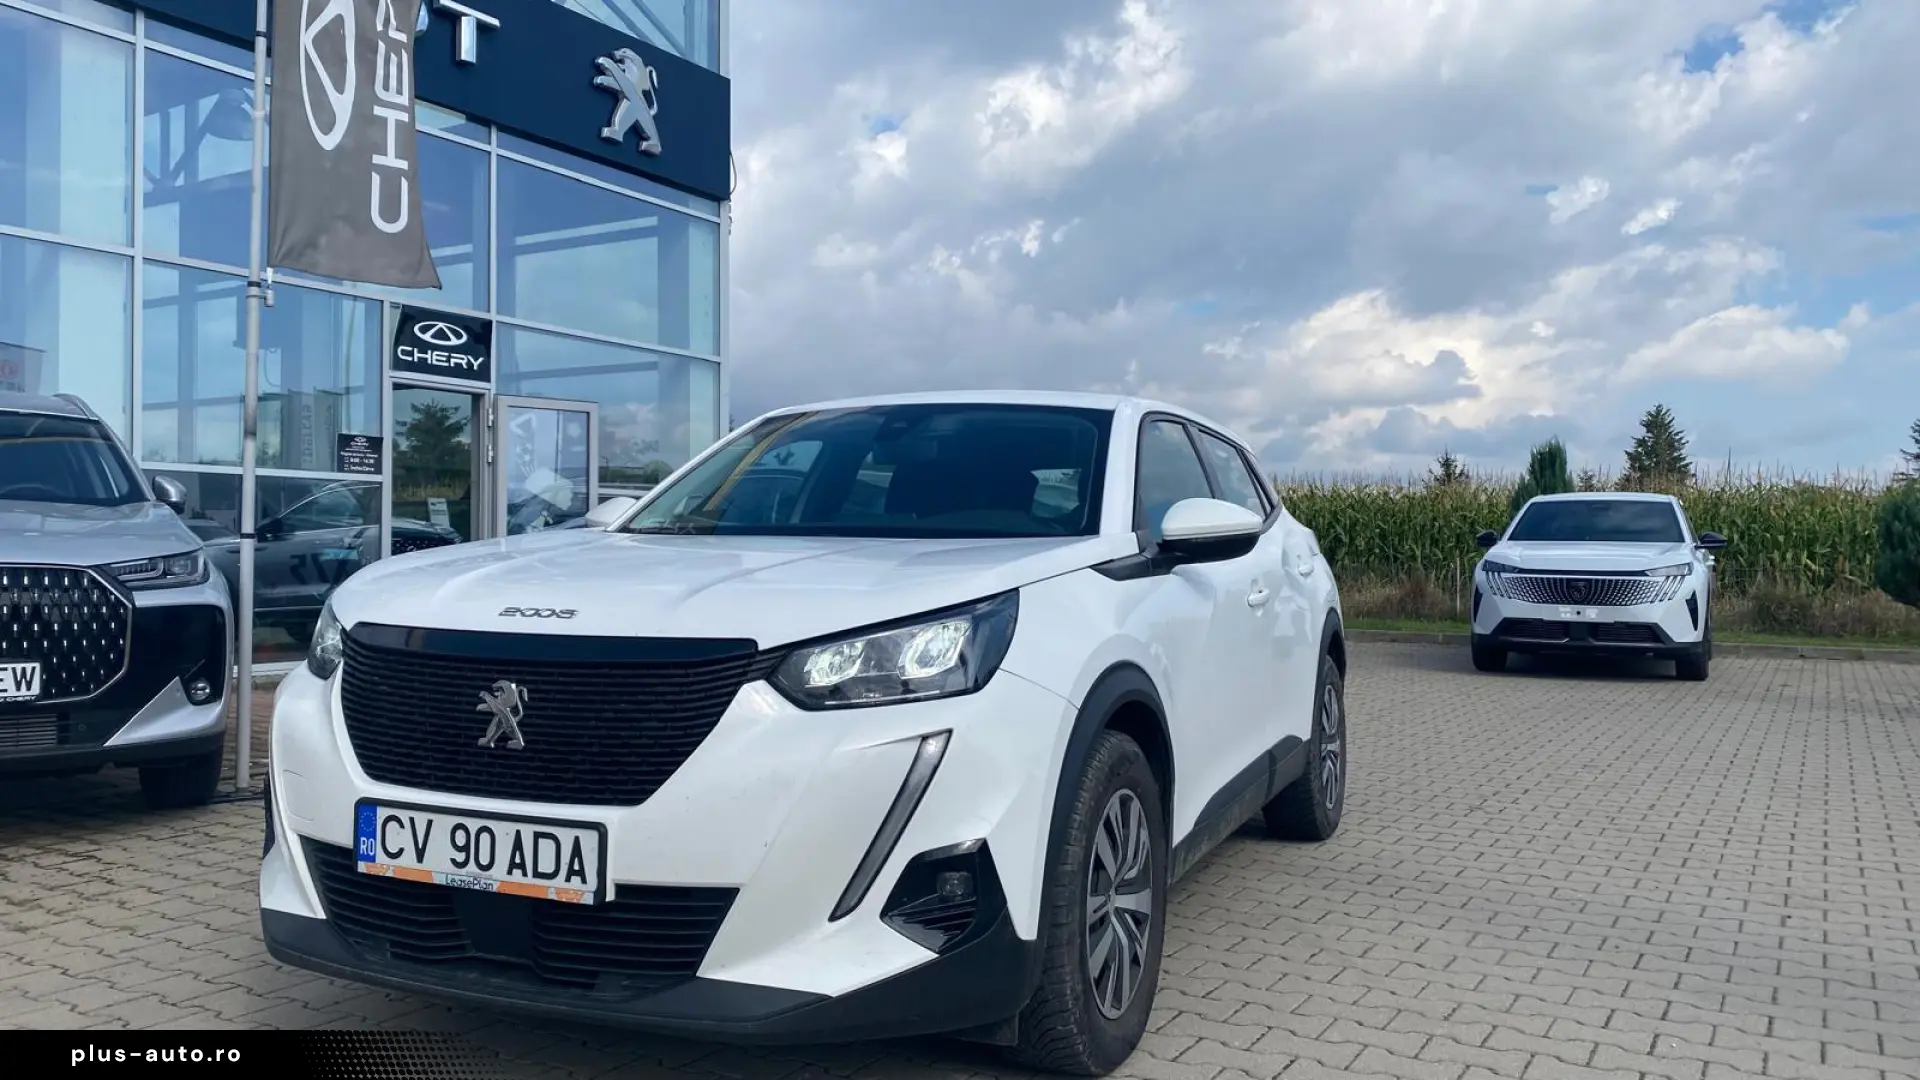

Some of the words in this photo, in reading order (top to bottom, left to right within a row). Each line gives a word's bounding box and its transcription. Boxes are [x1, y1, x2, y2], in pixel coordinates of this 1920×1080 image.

[371, 0, 409, 233] CHER
[397, 345, 485, 370] CHERY
[498, 606, 579, 619] 2008
[0, 666, 37, 692] EW
[360, 837, 376, 856] RO
[381, 814, 434, 864] CV
[450, 822, 497, 872] 90
[506, 829, 588, 884] ADA
[445, 873, 494, 891] LeasePlan
